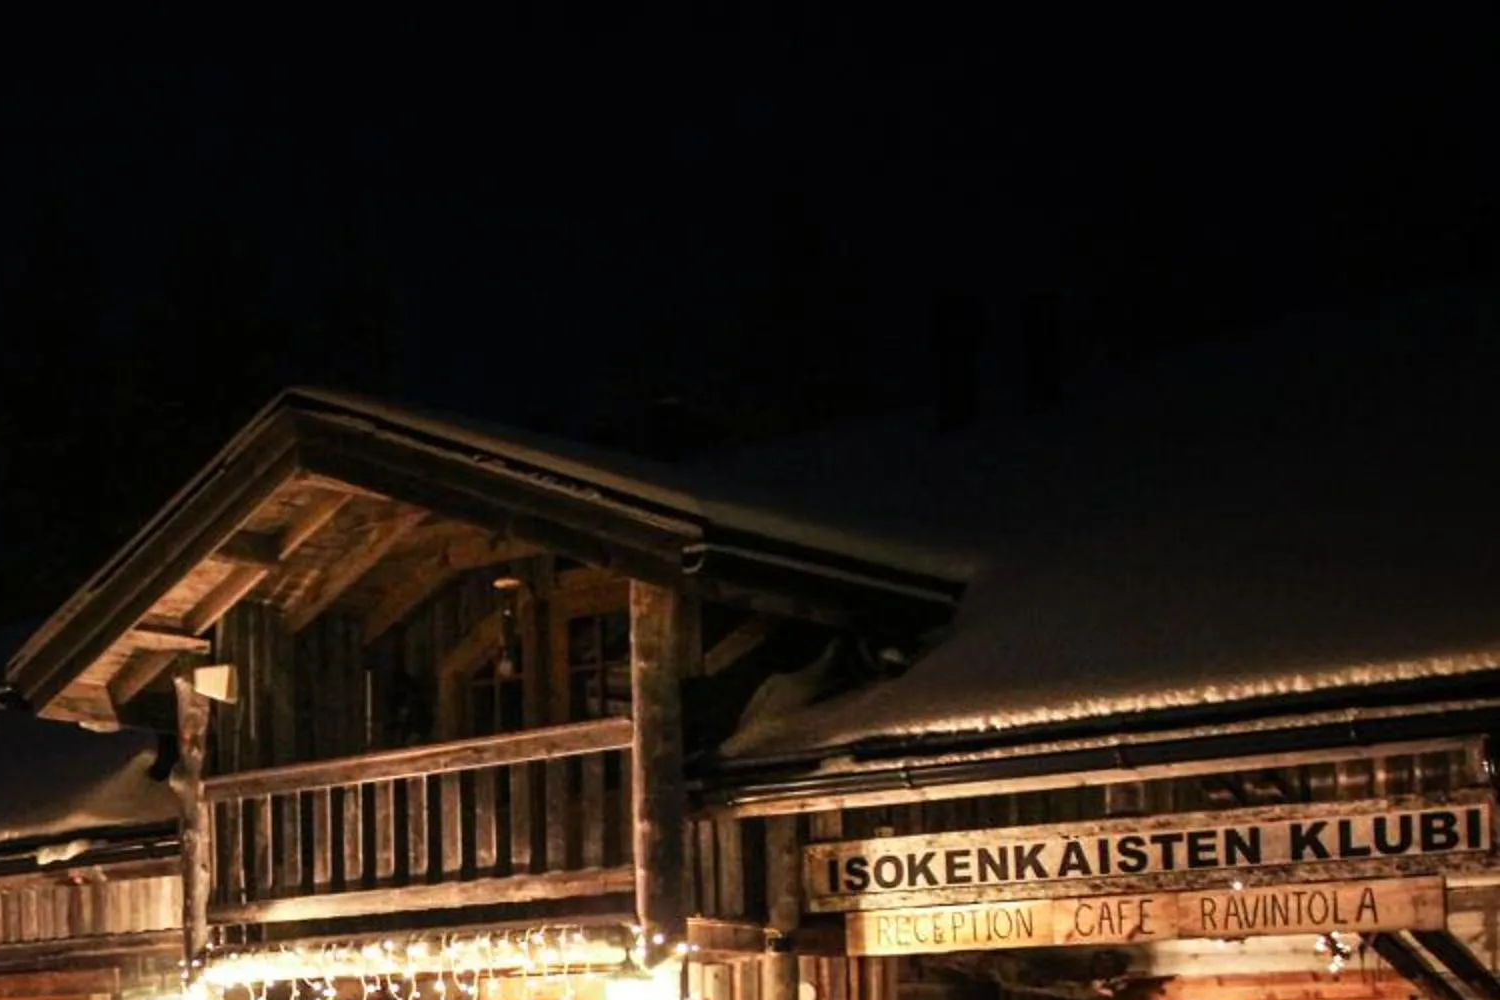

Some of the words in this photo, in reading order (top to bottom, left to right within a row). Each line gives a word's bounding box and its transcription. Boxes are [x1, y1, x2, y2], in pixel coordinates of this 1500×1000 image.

[828, 826, 1261, 893] ISOKENKÄISTEN
[1289, 808, 1481, 861] KLUBI
[876, 908, 1034, 947] RECEPTION
[1074, 899, 1155, 937] CAFE
[1200, 887, 1379, 931] RAVINTOLA
